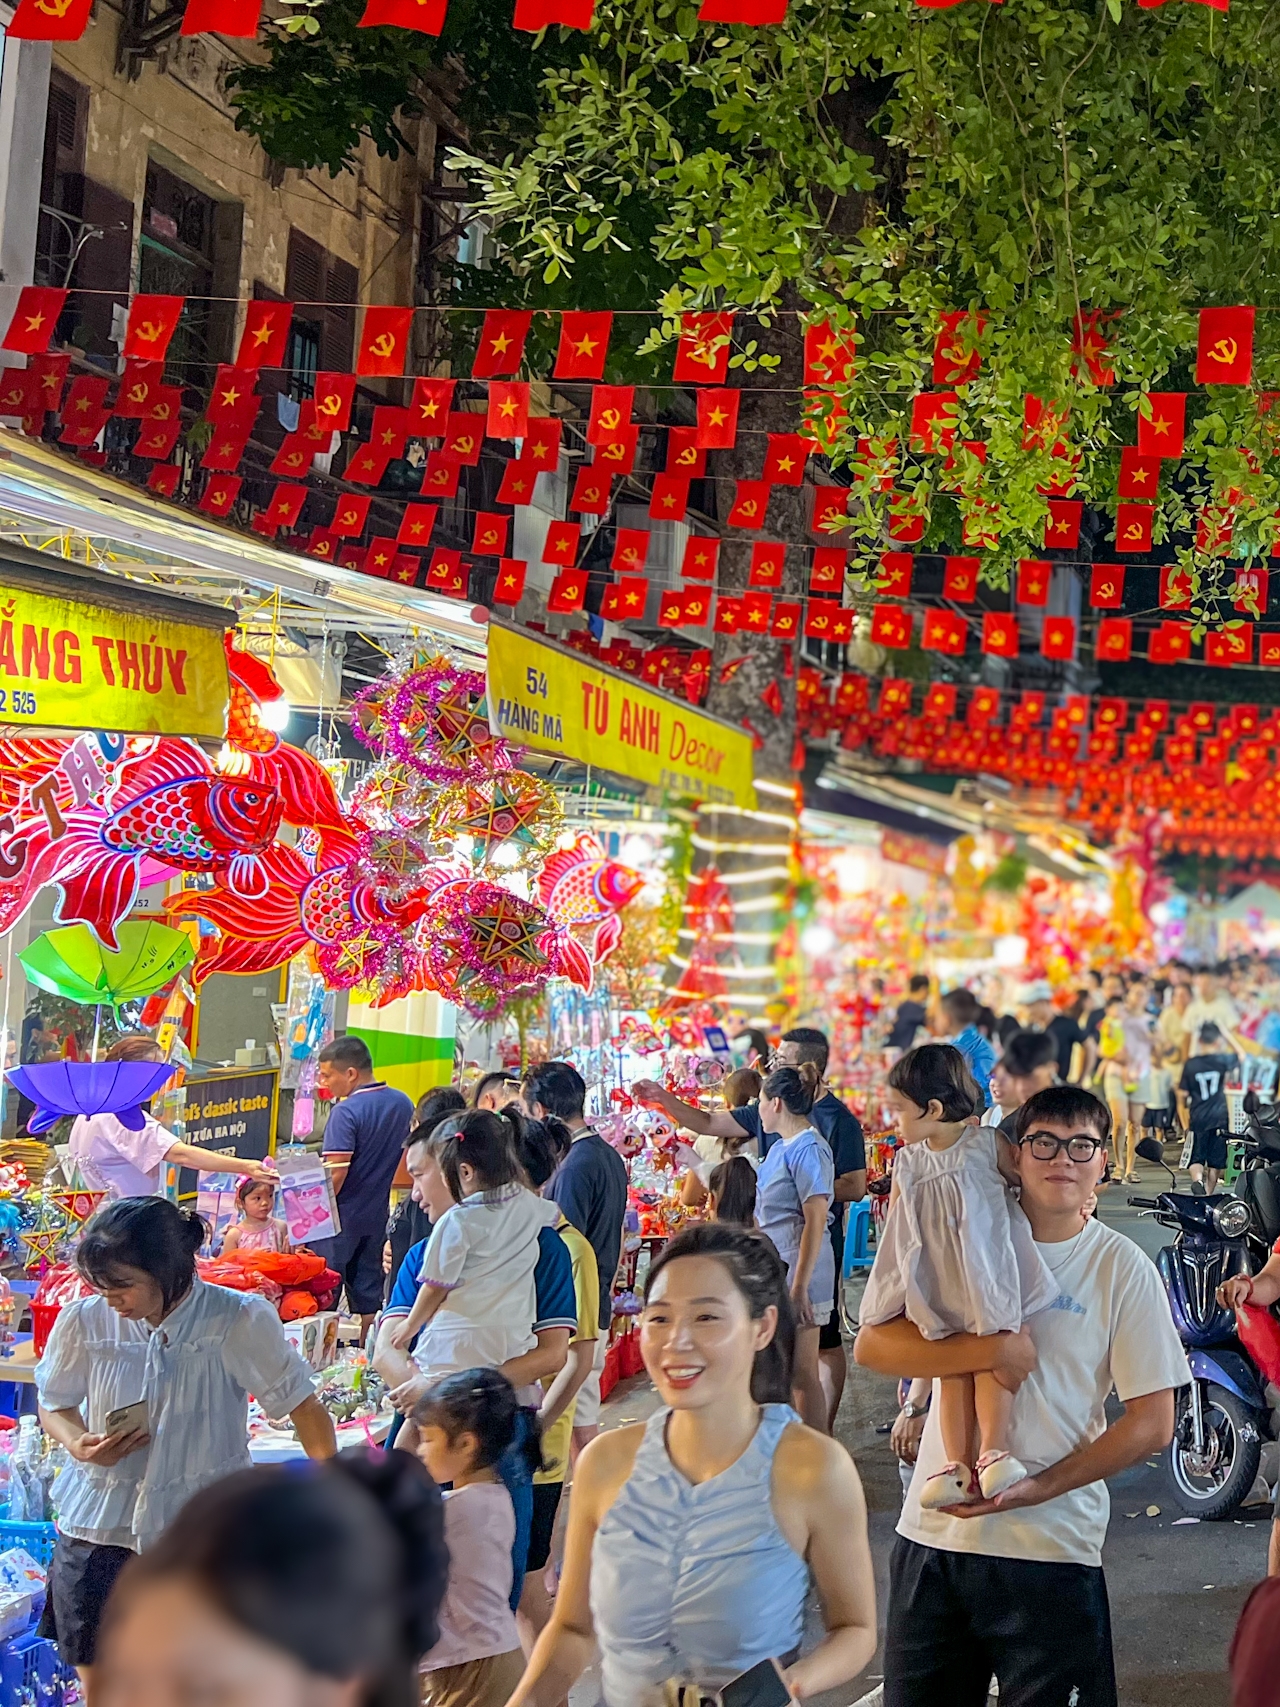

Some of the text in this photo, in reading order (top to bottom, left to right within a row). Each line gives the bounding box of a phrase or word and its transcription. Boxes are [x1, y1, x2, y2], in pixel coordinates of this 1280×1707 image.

[92, 634, 188, 696] THÚY
[526, 666, 548, 699] 54
[12, 689, 37, 715] 525
[497, 695, 563, 743] HÀNG MÃ
[581, 678, 726, 776] TÚ ANH Decor
[1195, 1071, 1220, 1100] 17
[203, 1097, 238, 1119] classic
[240, 1094, 269, 1113] taste
[229, 1121, 247, 1138] NỘI
